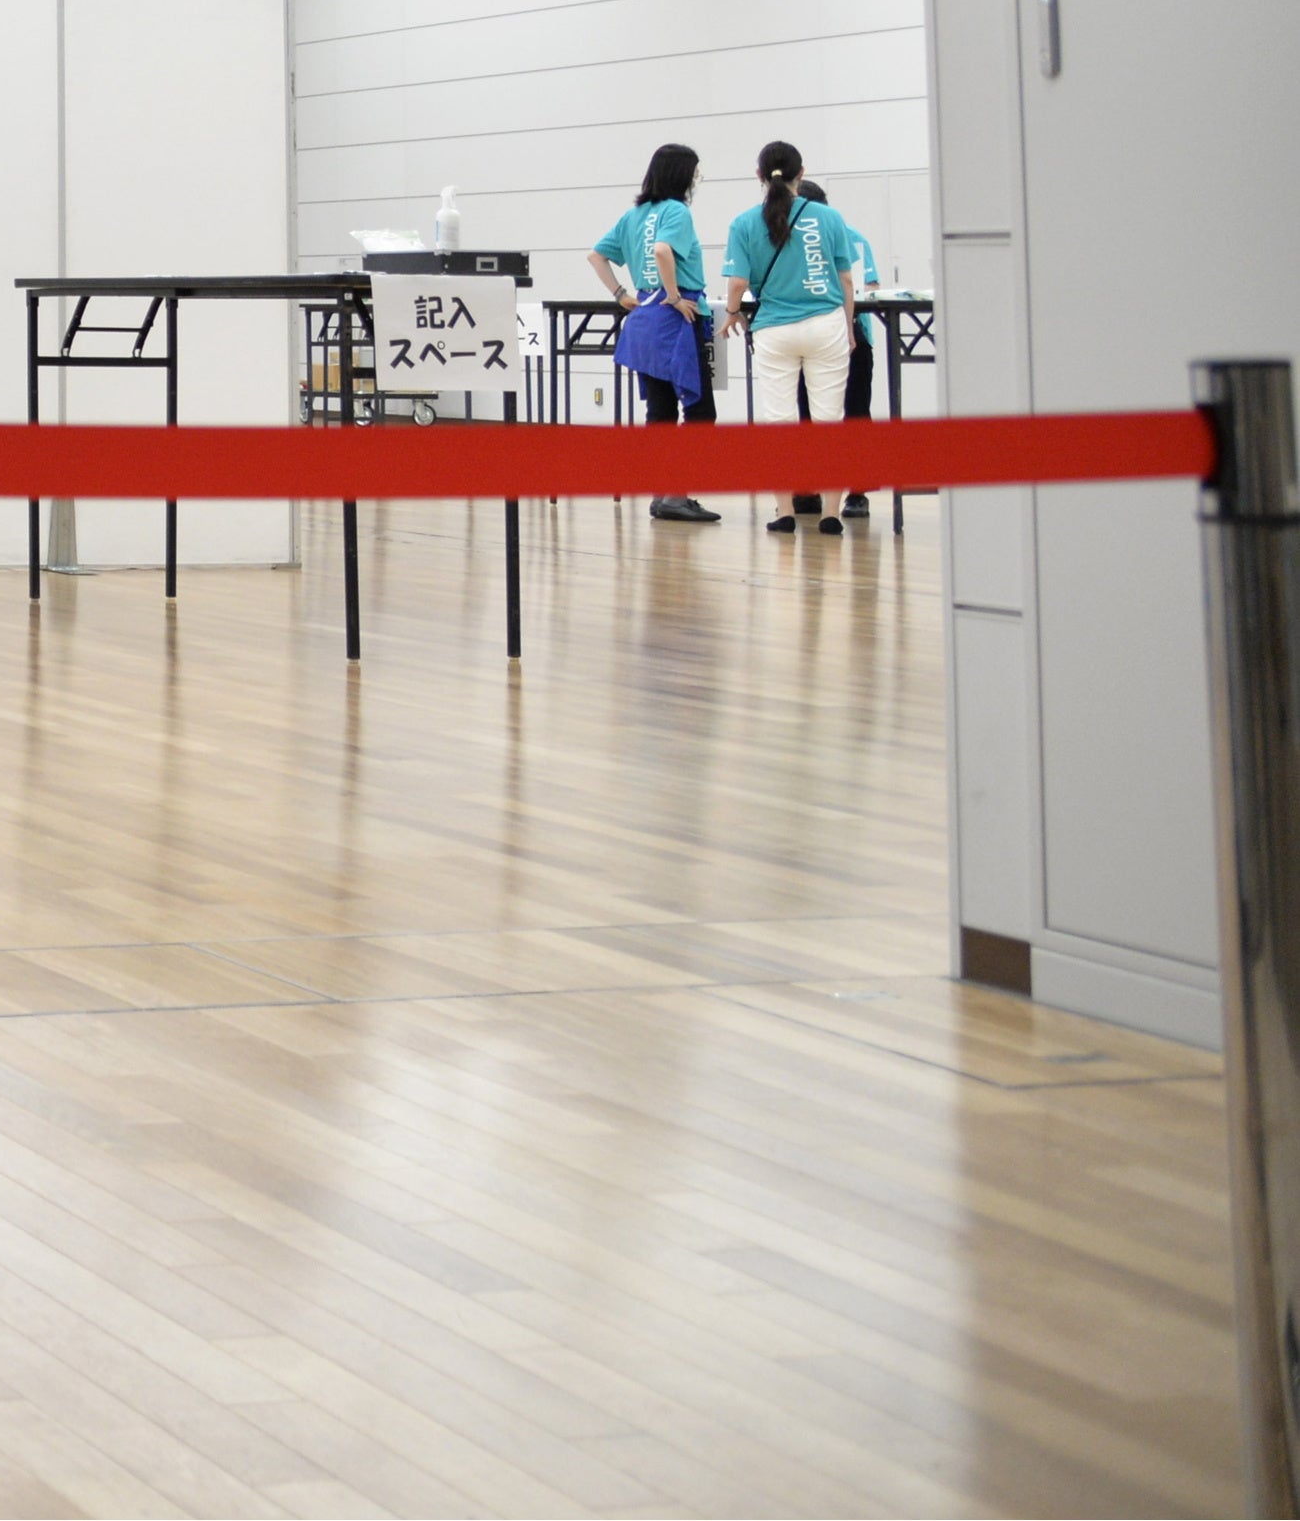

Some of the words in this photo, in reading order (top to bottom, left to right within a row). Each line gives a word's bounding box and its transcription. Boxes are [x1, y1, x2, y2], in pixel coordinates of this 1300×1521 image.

[795, 217, 830, 296] ryoushi.jp
[414, 295, 477, 329] 記入
[389, 338, 508, 370] スペース
